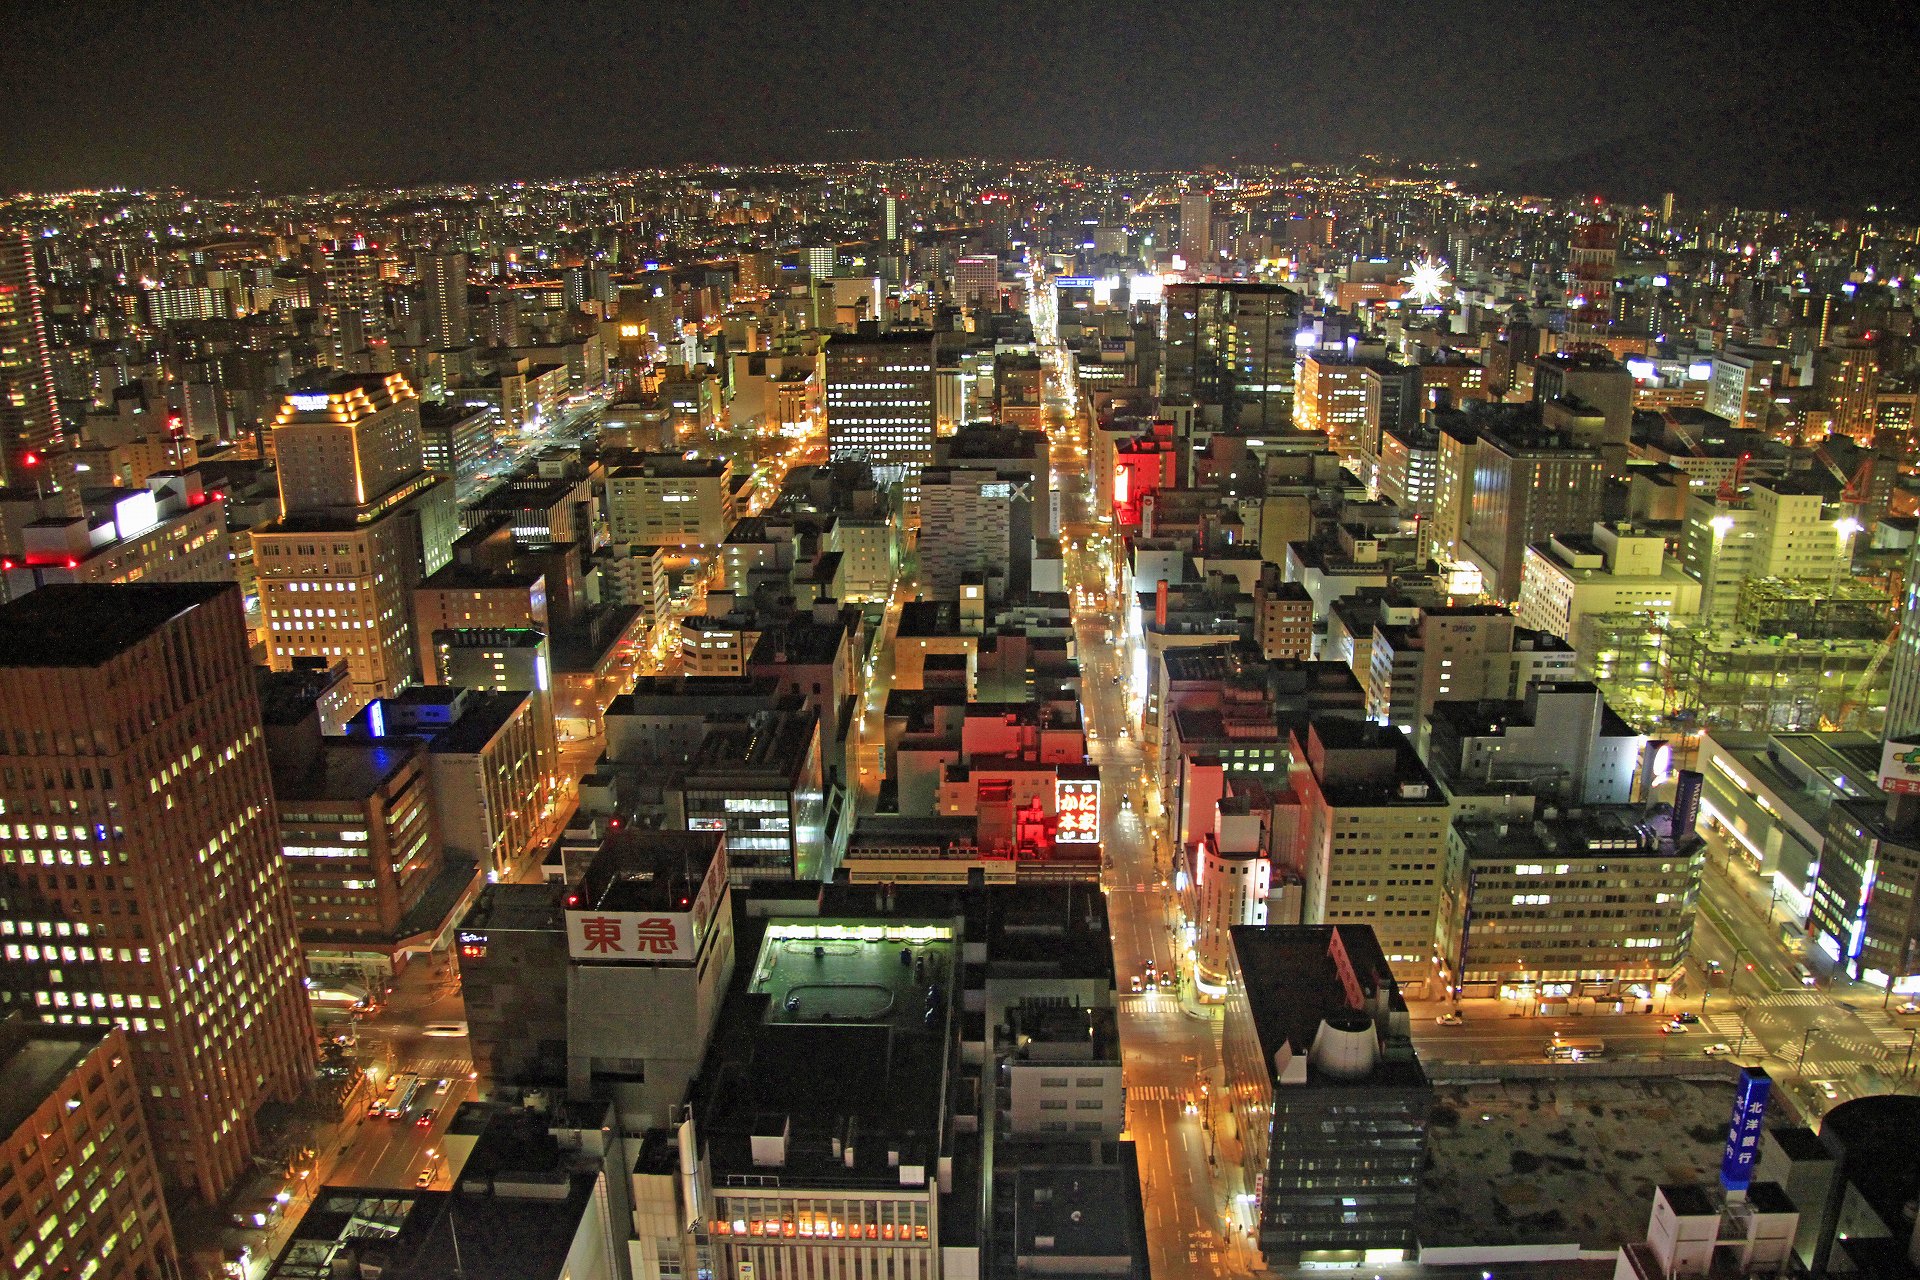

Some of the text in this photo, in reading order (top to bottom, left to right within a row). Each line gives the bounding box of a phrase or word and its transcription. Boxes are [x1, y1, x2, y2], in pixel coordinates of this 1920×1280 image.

[1884, 779, 1920, 793] 第一生
[1060, 794, 1096, 811] かに
[1058, 812, 1097, 831] 本家
[581, 916, 679, 954] 東急
[1738, 1102, 1763, 1164] 北洋銀行
